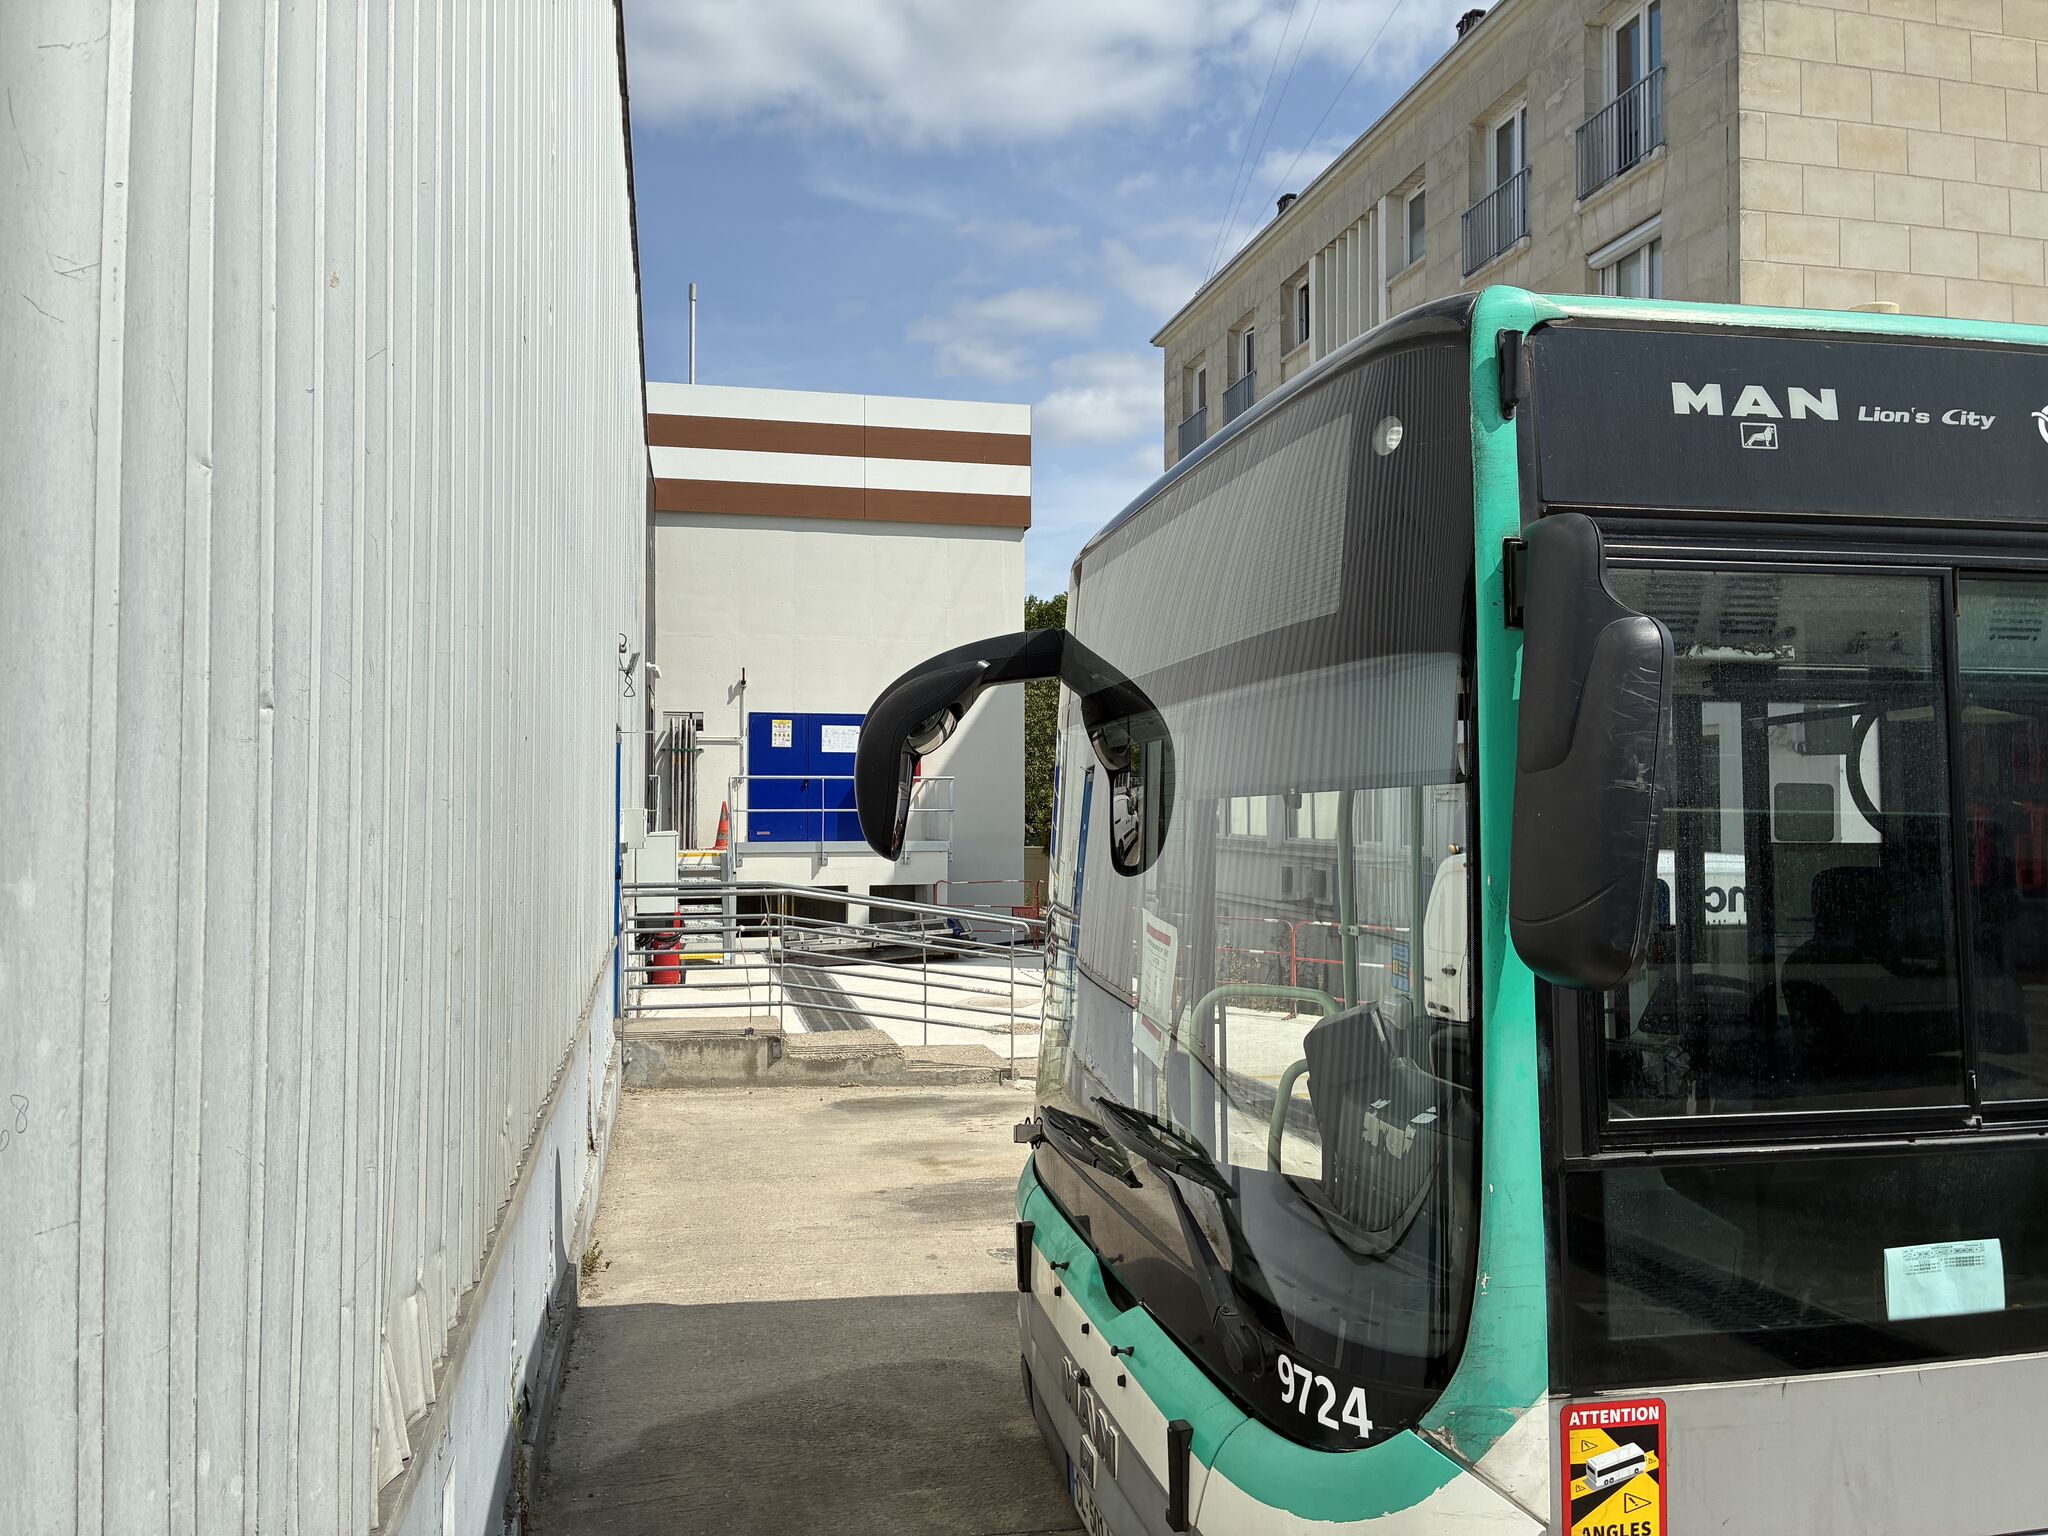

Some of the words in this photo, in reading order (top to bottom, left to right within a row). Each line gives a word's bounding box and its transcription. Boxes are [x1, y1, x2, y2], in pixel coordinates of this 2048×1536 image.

[1671, 381, 1839, 421] MAN
[1858, 405, 1931, 424] Lion's
[1941, 408, 1997, 430] City
[1277, 1354, 1373, 1439] 9724
[1569, 1405, 1659, 1427] ATTENTION
[1062, 1356, 1120, 1480] MAN
